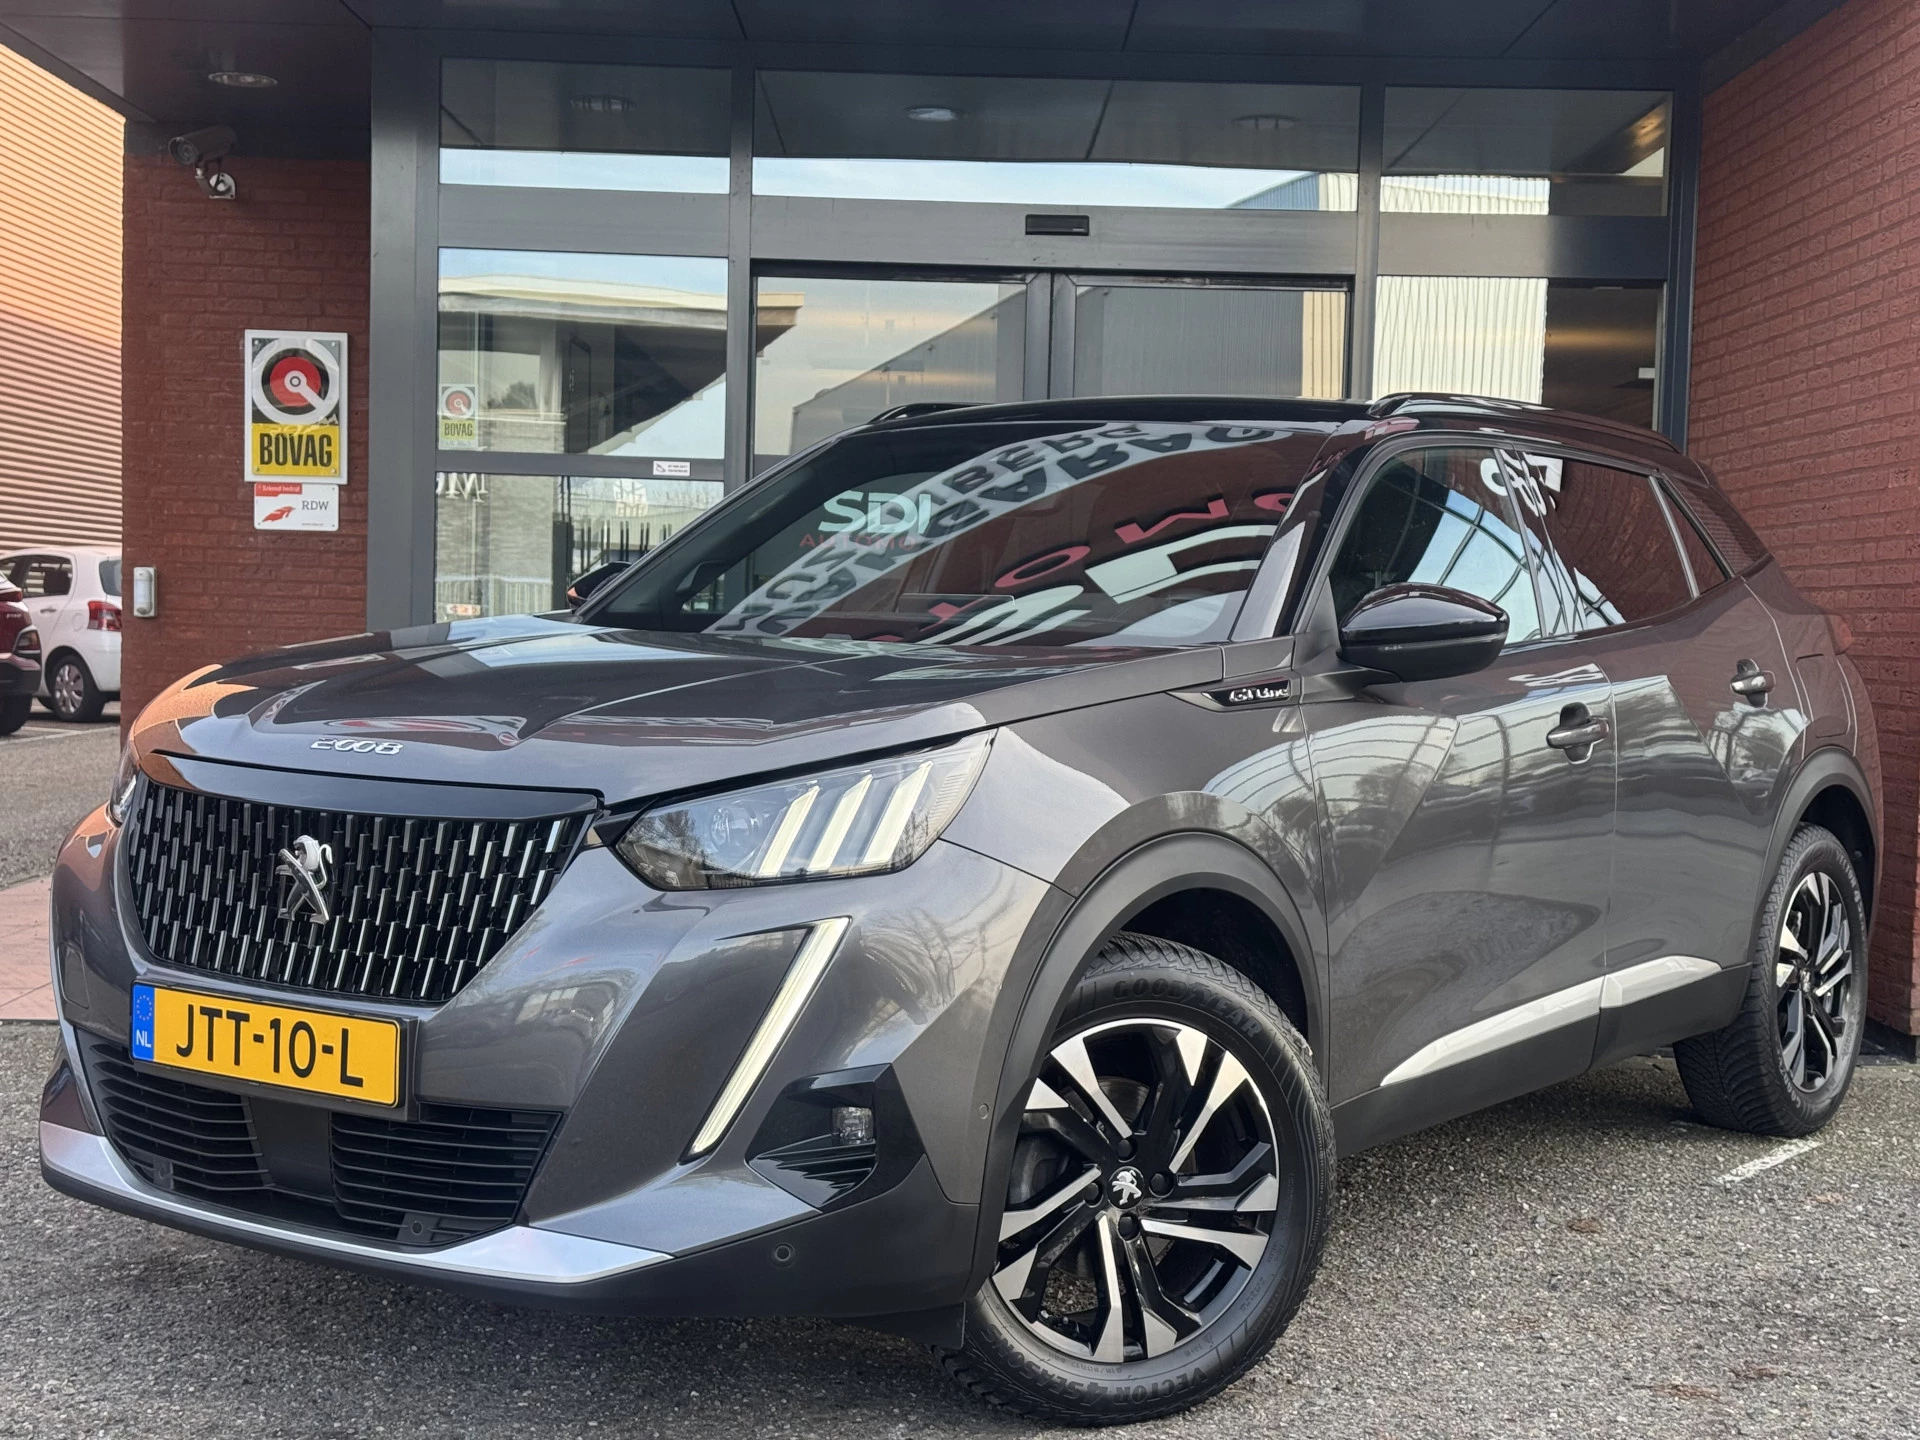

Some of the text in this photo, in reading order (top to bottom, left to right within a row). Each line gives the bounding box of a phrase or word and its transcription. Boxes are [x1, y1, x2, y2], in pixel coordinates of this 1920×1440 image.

[444, 423, 473, 436] BOVAG
[259, 433, 332, 467] BOVAG
[302, 501, 329, 510] RDW
[818, 490, 931, 534] SDI
[310, 738, 403, 755] 2008
[1112, 978, 1264, 1038] GOODYEAR
[136, 1029, 151, 1048] NL
[176, 1004, 363, 1087] JTT-10-L
[1113, 1366, 1208, 1406] VECTOR
